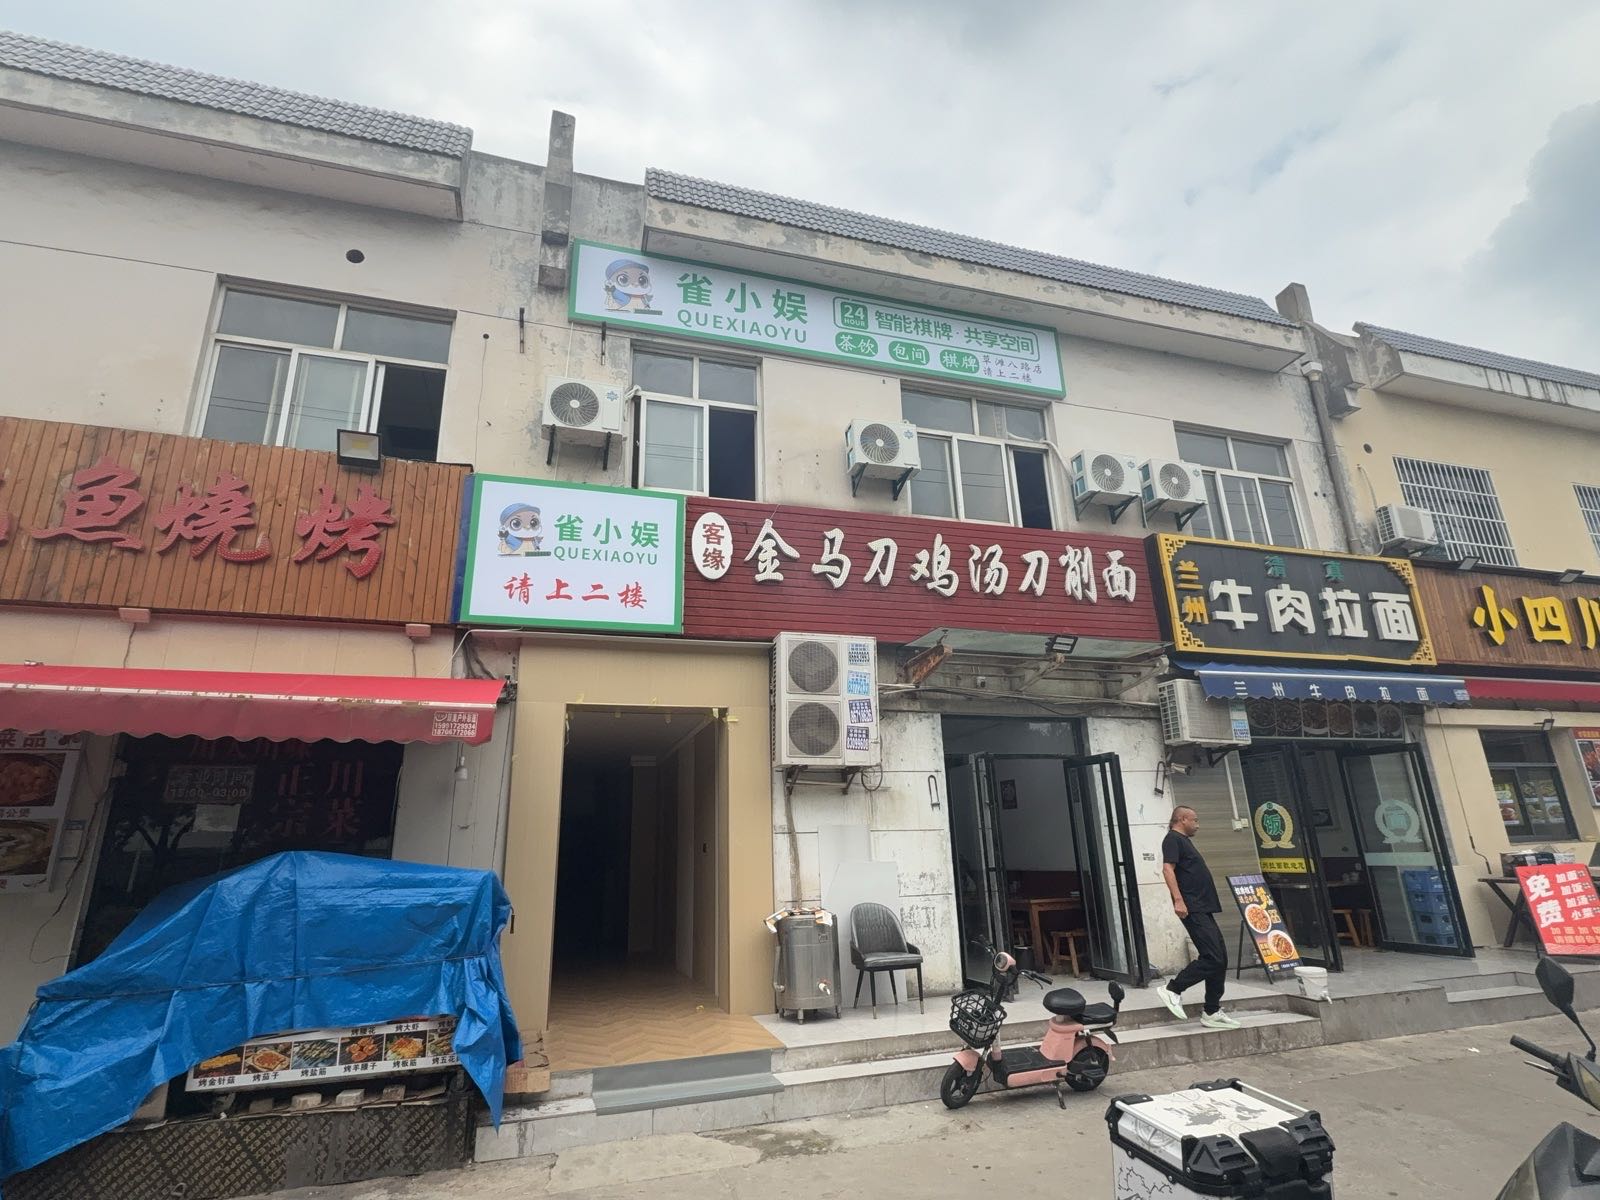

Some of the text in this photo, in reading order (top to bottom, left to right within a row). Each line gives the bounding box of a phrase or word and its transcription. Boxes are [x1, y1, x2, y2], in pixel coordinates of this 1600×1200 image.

[676, 272, 808, 326] 雀小娱
[844, 305, 865, 320] 24
[677, 308, 808, 345] QUEXIAOYU
[844, 317, 866, 328] HOUR
[838, 335, 877, 356] 茶饮
[892, 344, 927, 364] 包间
[942, 351, 978, 371] 棋牌
[982, 366, 1033, 383] 请上二楼
[553, 513, 660, 549] 雀小娱
[553, 545, 658, 566] QUEXIAOYU
[702, 522, 726, 571] 客缘
[744, 519, 1137, 603] 金马刀鸡汤刀削面
[1264, 554, 1346, 583] 清真
[503, 572, 647, 609] 请上二楼
[1176, 559, 1209, 625] 兰州
[1208, 578, 1419, 642] 牛肉拉面
[1526, 874, 1565, 928] 免费
[198, 1076, 236, 1087] 烤金针菇
[252, 1071, 280, 1082] 烤茄子
